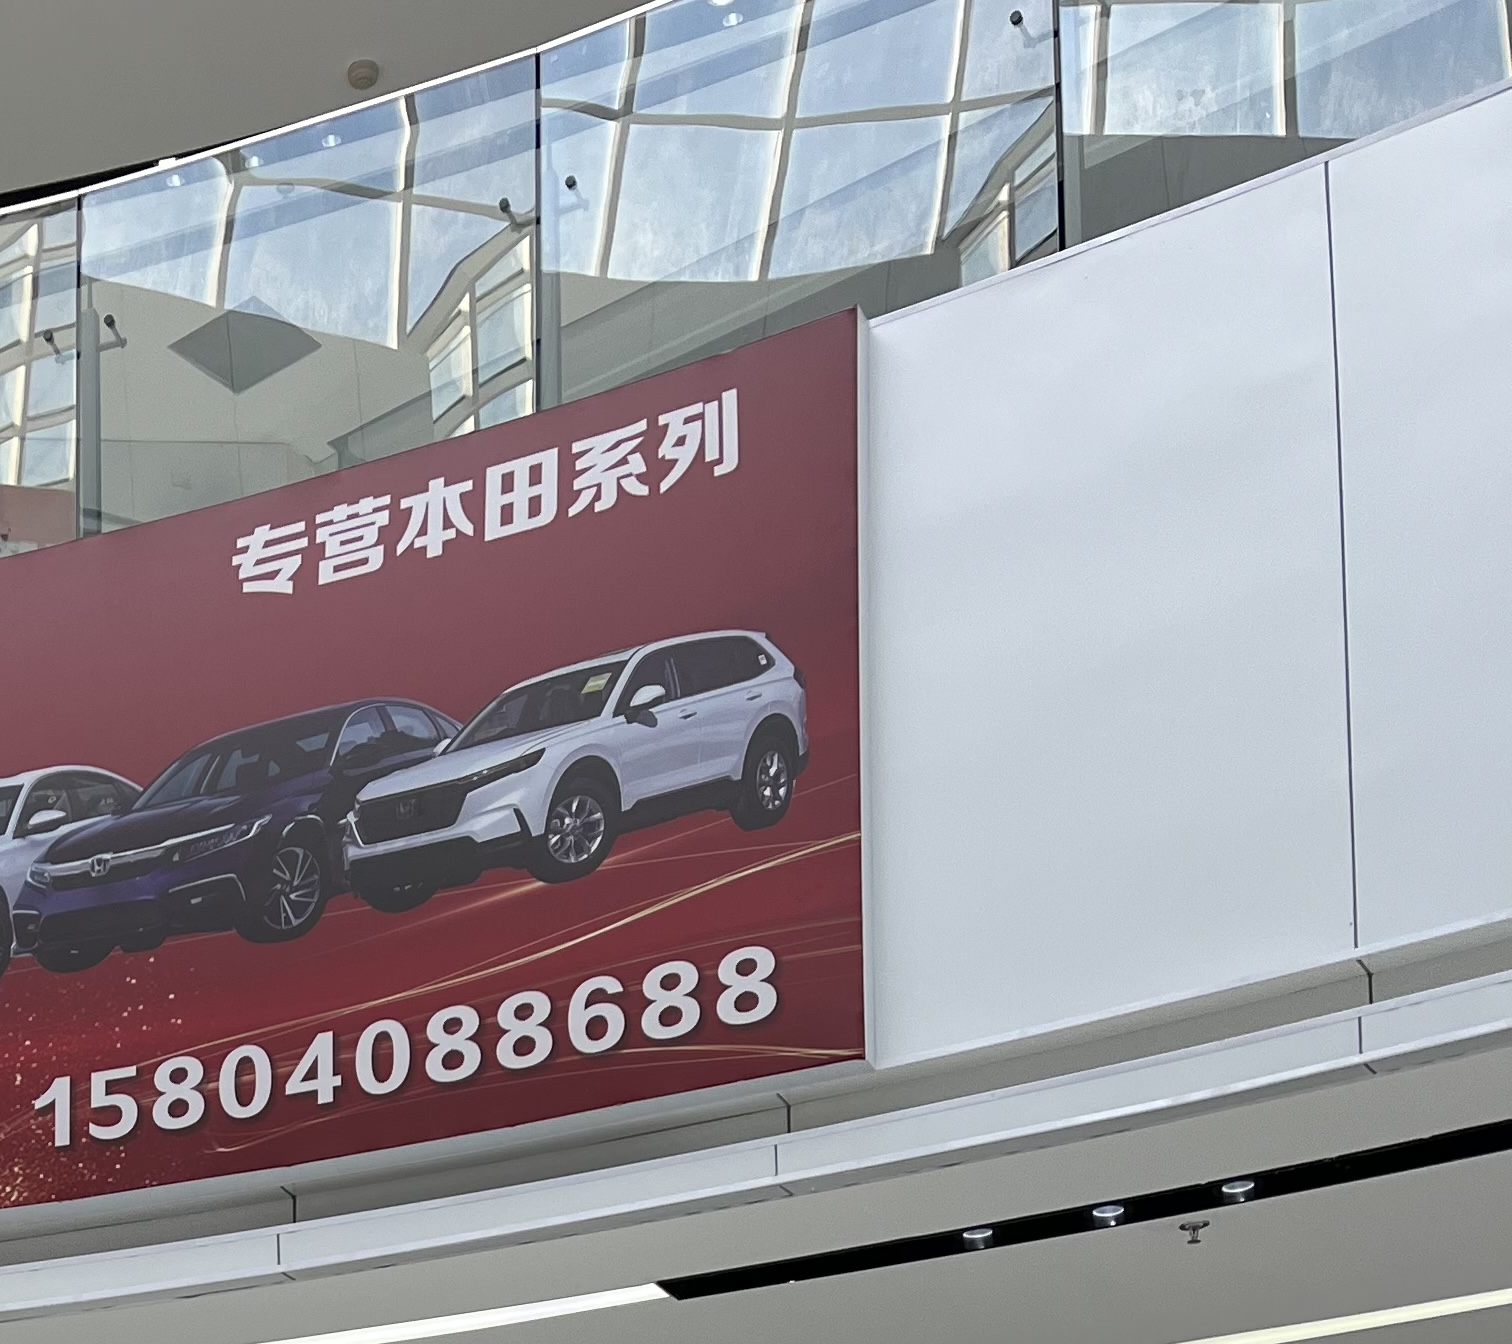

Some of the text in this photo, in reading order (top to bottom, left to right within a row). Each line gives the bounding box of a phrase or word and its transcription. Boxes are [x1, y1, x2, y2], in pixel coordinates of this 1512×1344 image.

[231, 388, 739, 595] 专营本田系列
[33, 945, 778, 1147] 15804088688
